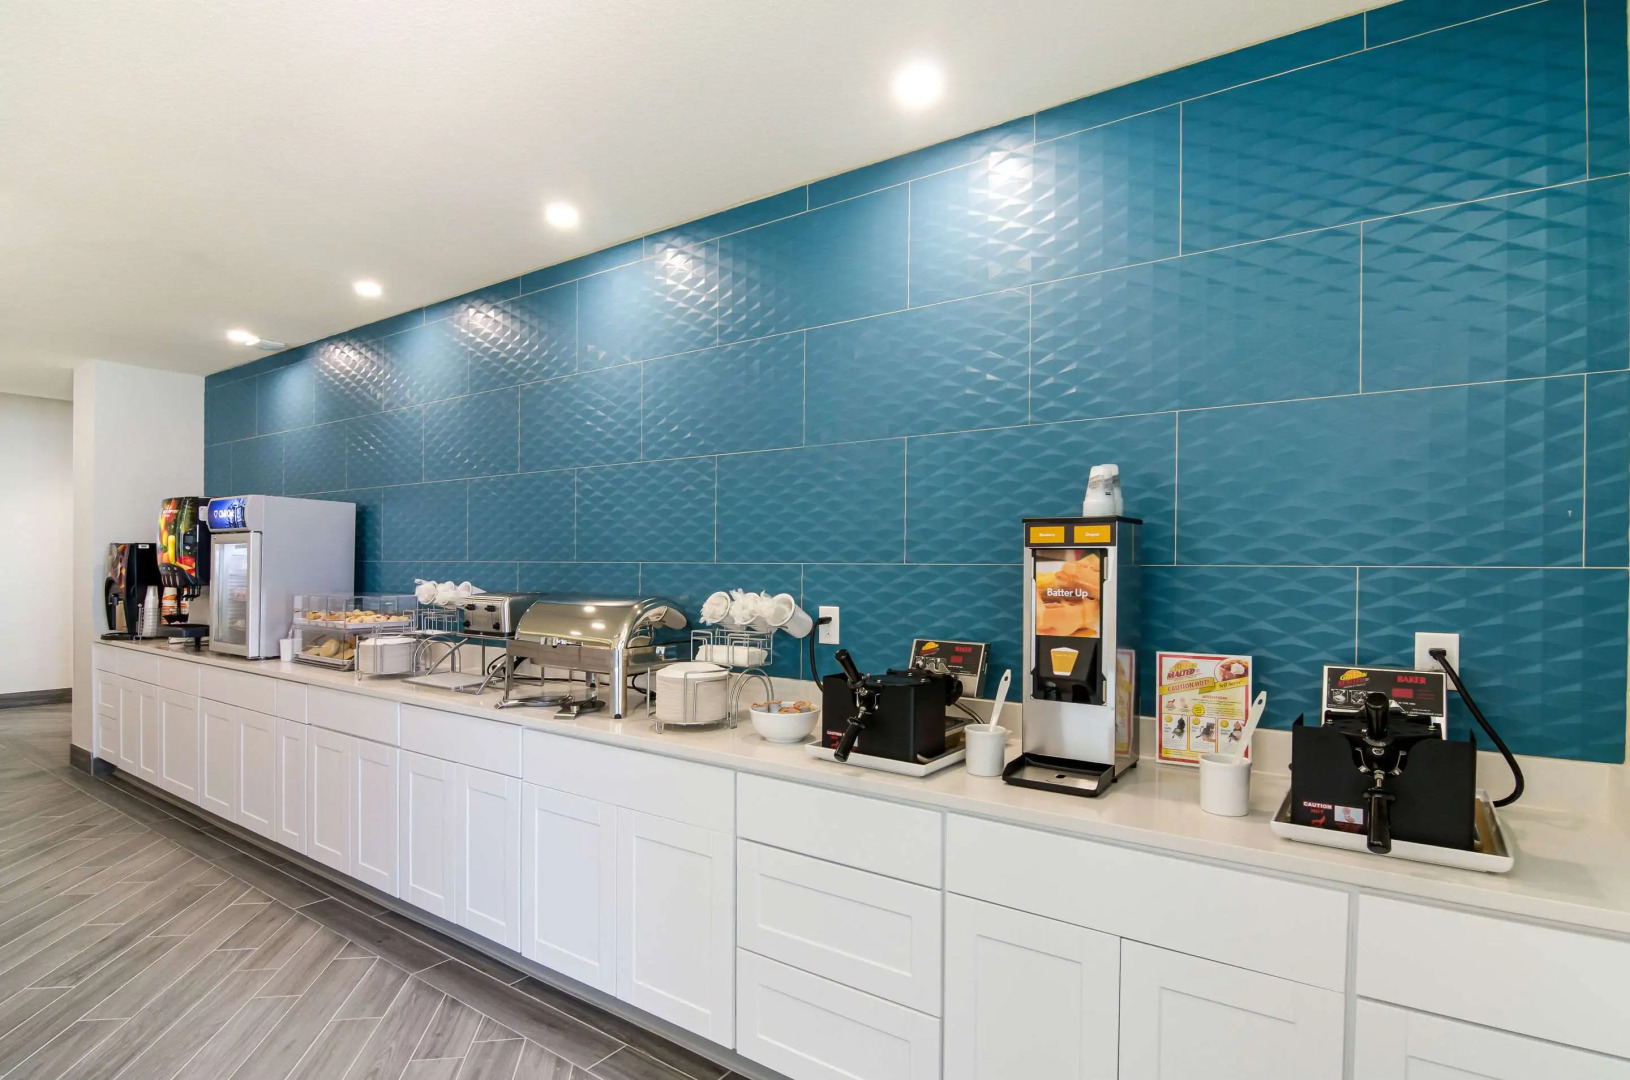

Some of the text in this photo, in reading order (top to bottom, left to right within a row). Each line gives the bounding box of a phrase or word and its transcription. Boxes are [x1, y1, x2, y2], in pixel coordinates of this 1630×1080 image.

[1047, 588, 1088, 599] Batter Up
[1167, 668, 1196, 680] MALTED
[1397, 675, 1427, 685] BAKER
[1167, 682, 1194, 692] CAUTION
[1303, 801, 1333, 810] CAUTION
